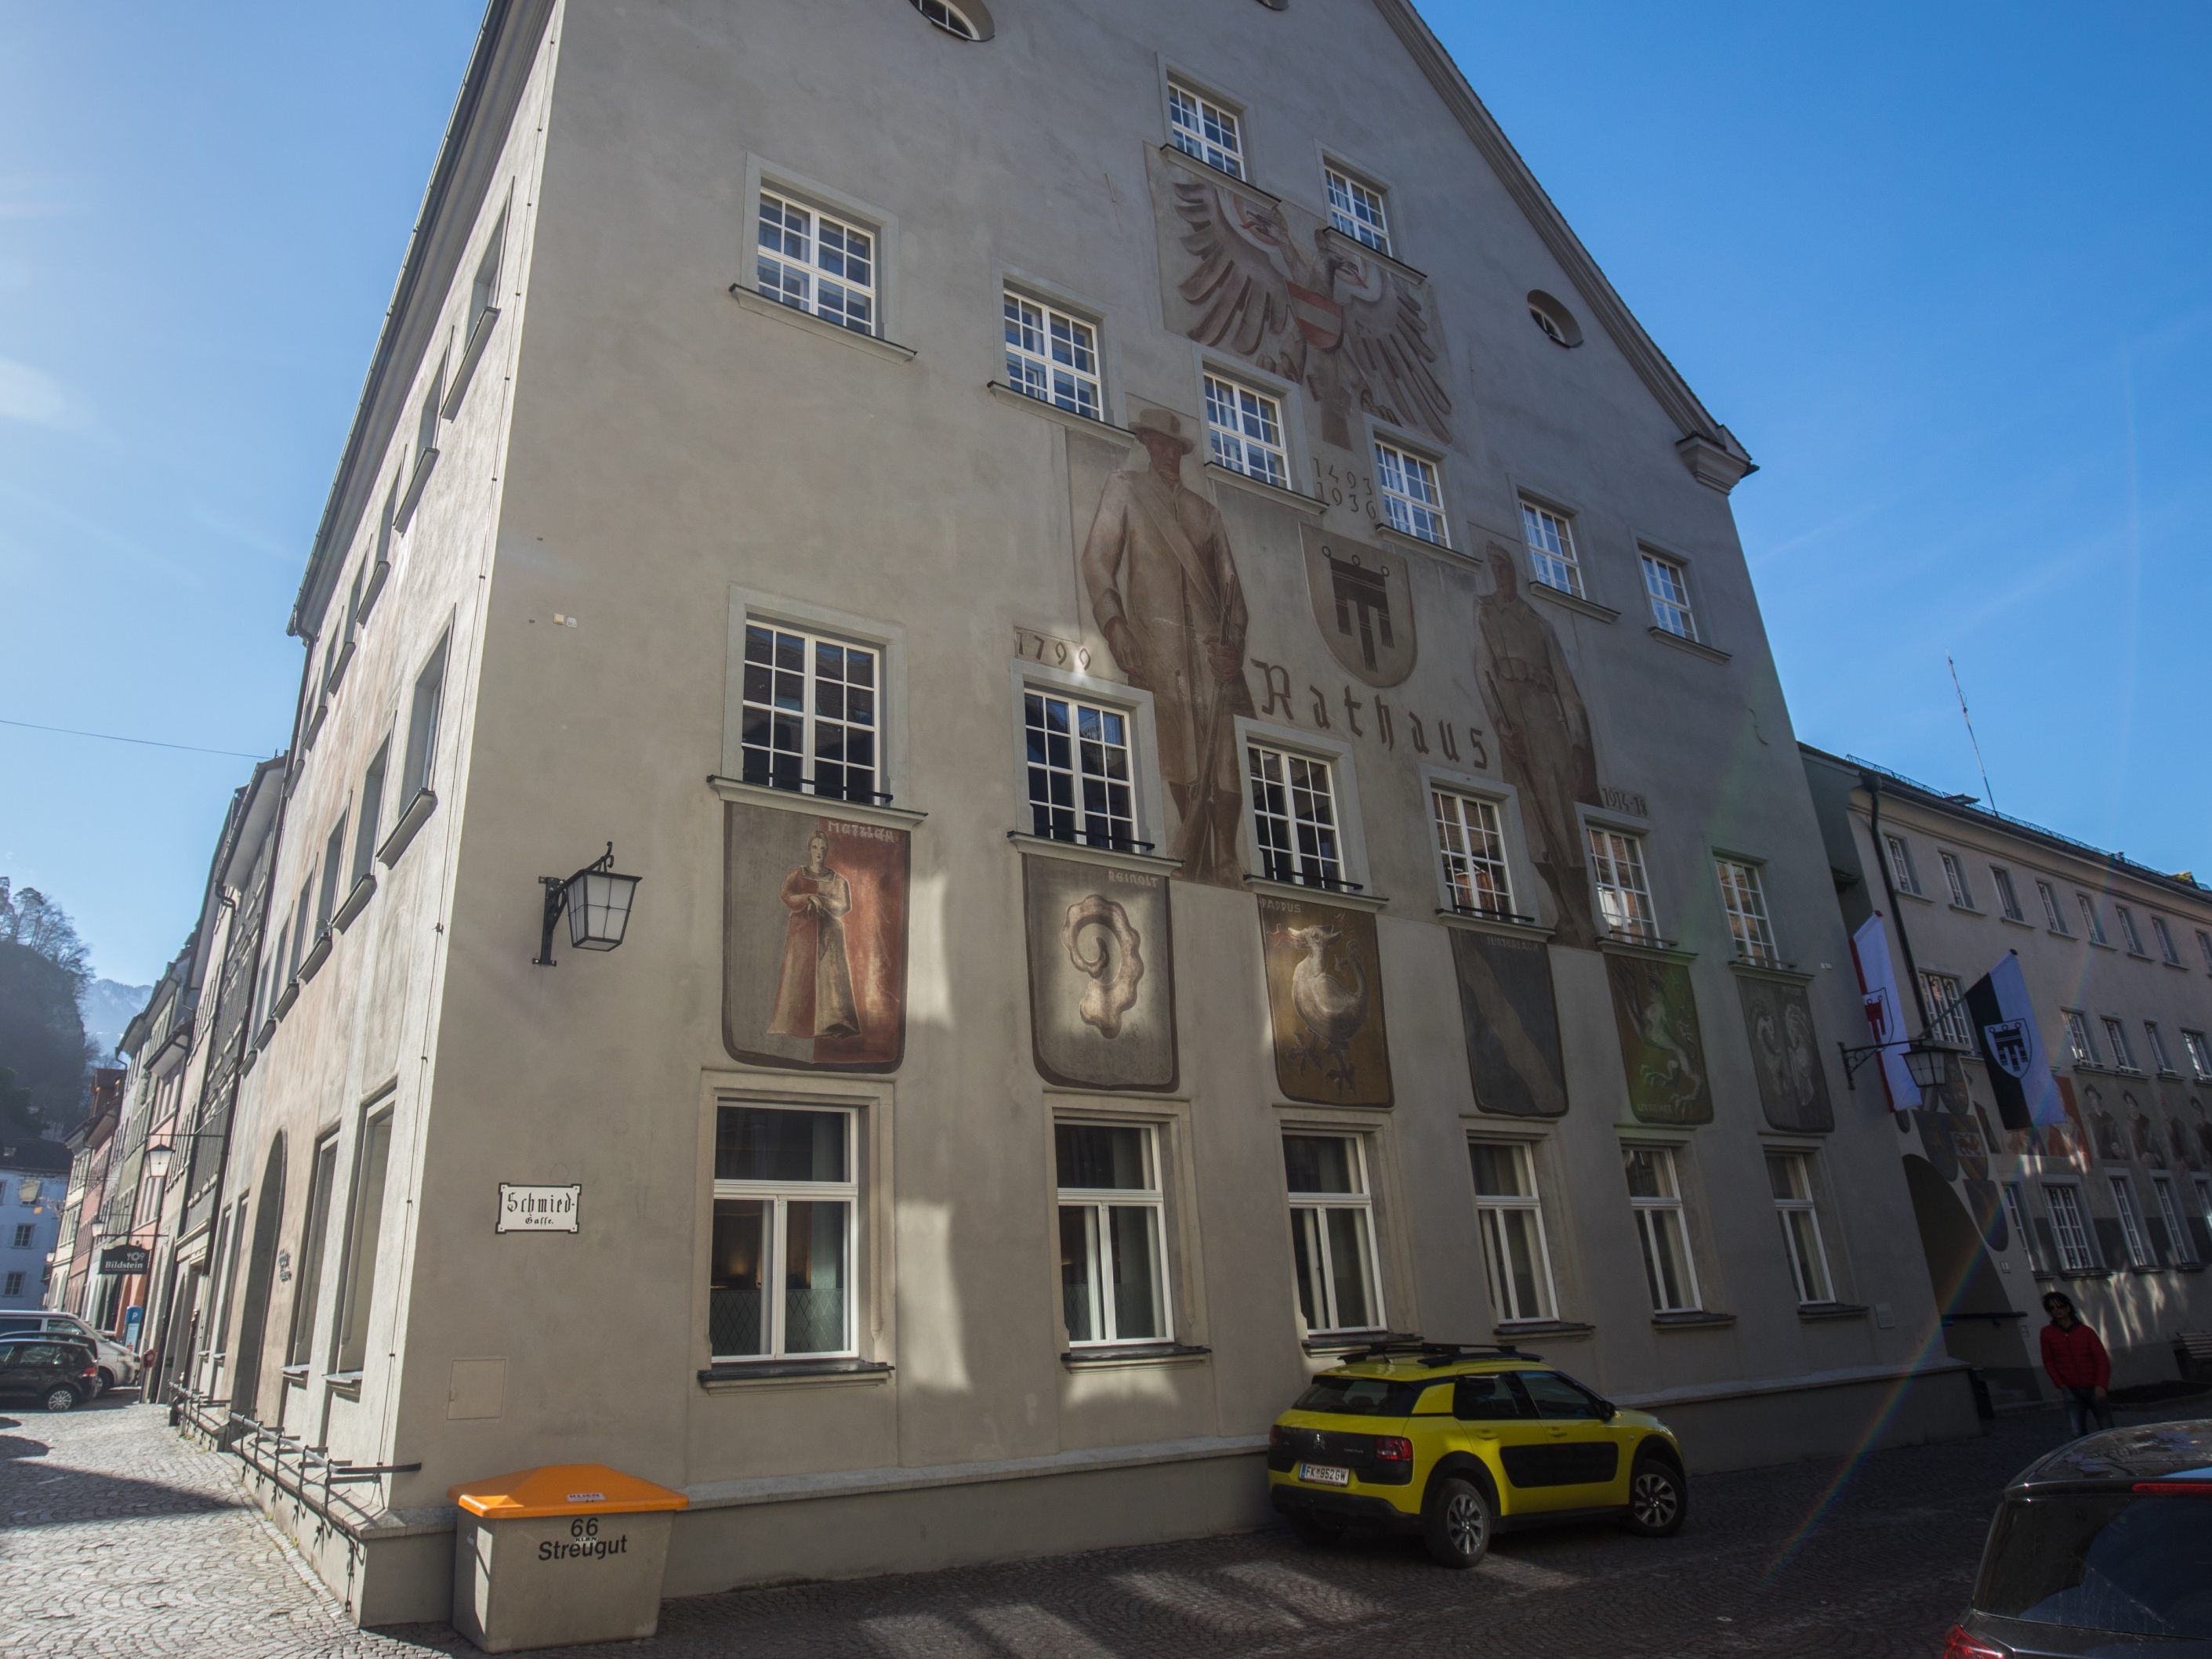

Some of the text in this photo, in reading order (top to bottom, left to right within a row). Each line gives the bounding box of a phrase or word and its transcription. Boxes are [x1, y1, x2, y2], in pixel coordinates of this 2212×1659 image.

[1313, 457, 1372, 495] 1493
[1016, 632, 1091, 671] 1799
[1249, 658, 1487, 770] Rathaus
[132, 1312, 138, 1320] P
[571, 1517, 599, 1537] 66
[538, 1534, 628, 1561] Streugut
